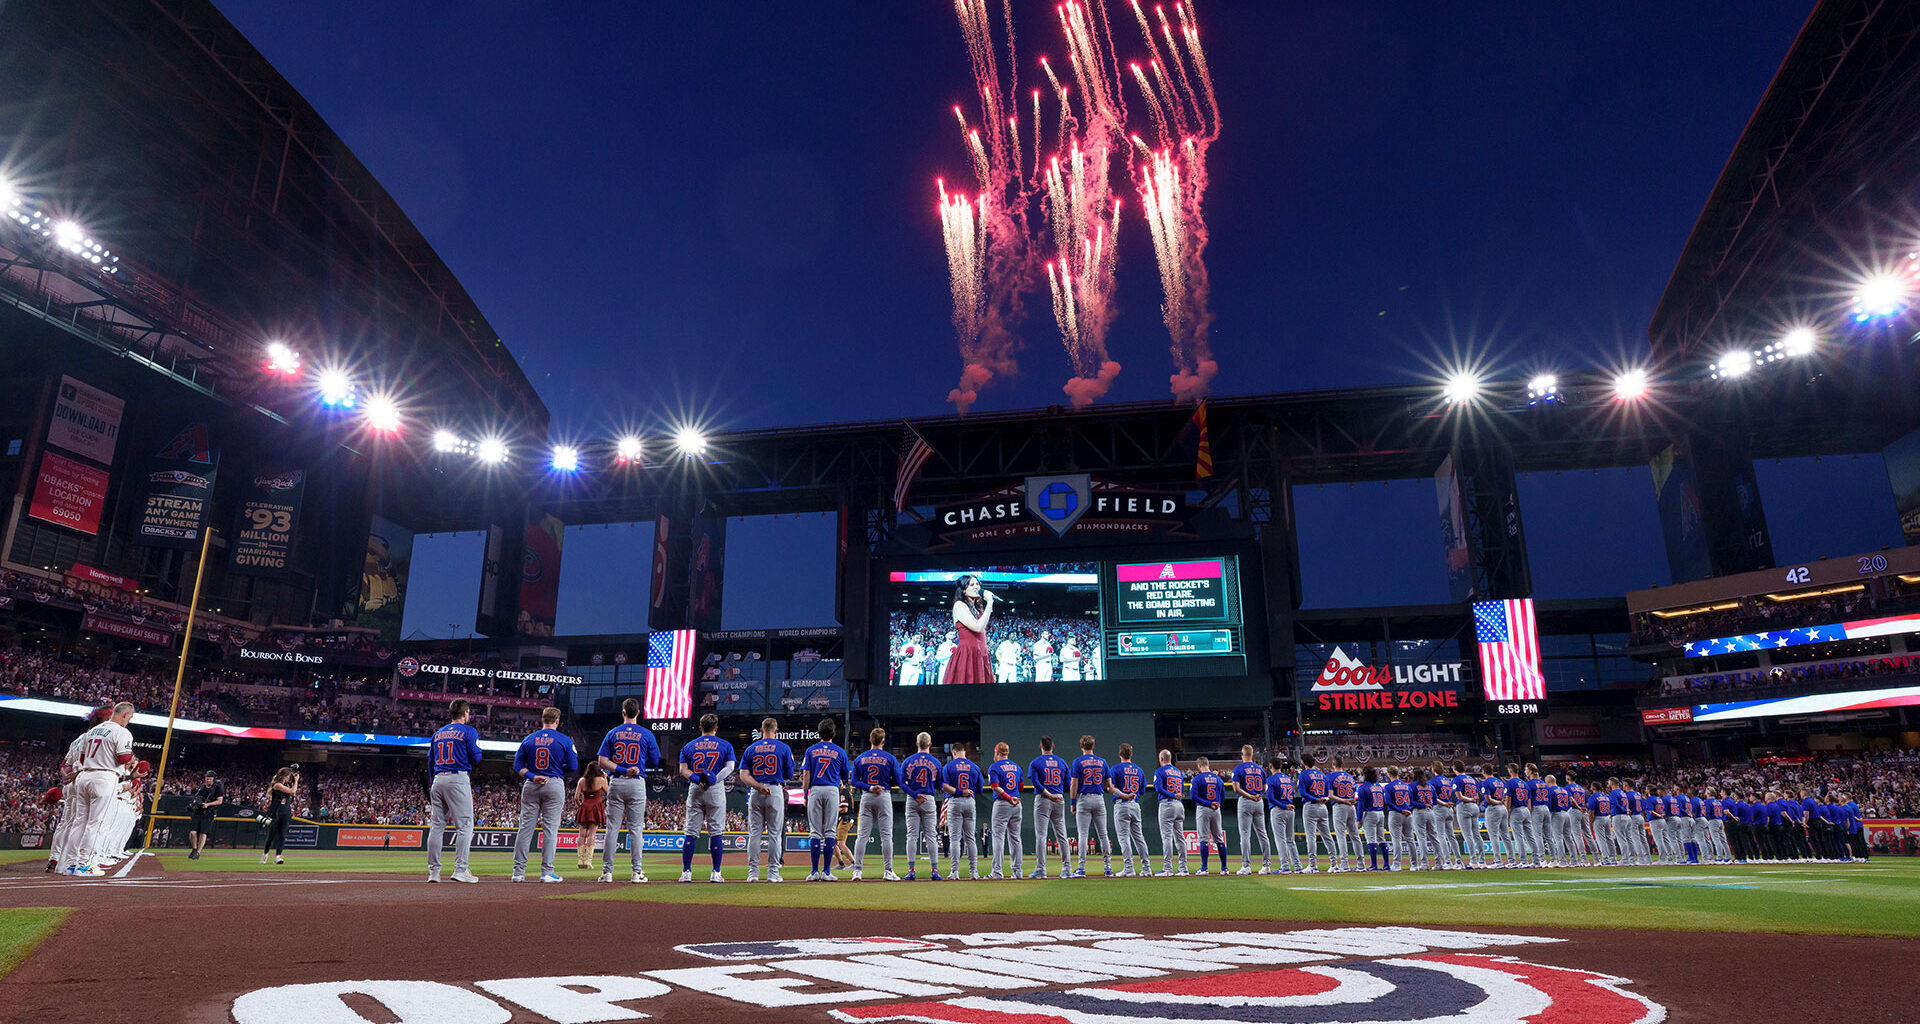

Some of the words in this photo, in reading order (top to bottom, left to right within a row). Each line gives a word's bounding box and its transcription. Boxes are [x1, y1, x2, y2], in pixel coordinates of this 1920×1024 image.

[56, 403, 106, 434] DOWNLOAD
[107, 423, 118, 438] IT
[271, 477, 296, 490] Back
[49, 487, 92, 507] LOCATION
[147, 497, 203, 512] STREAM
[52, 506, 81, 522] 69050
[145, 507, 168, 518] ANY
[171, 510, 201, 521] GAME
[245, 501, 294, 512] CELEBRATING
[944, 502, 1021, 525] CHASE
[1098, 497, 1177, 514] FIELD
[143, 516, 200, 529] ANYWHERE
[244, 508, 293, 532] $93
[240, 529, 289, 543] MILLION
[972, 530, 998, 539] HOME
[1004, 527, 1017, 535] OF
[1023, 525, 1041, 533] THE
[1076, 522, 1149, 532] DIAMONDBACKS
[237, 547, 287, 558] CHARITABLE
[258, 541, 268, 549] IN
[235, 555, 285, 569] GIVING
[1857, 554, 1888, 574] 20
[89, 569, 124, 584] Honeywell
[1785, 566, 1811, 584] 42
[1131, 583, 1149, 591] AND
[1151, 582, 1168, 590] THE
[1169, 580, 1210, 589] ROCKET'S
[1147, 591, 1163, 600] RED
[1127, 601, 1144, 609] THE
[1146, 600, 1171, 609] BOMB
[1172, 598, 1216, 608] BURSTING
[1156, 609, 1166, 617] IN
[144, 630, 161, 641] SEATS
[711, 631, 728, 639] WEST
[729, 630, 766, 638] CHAMPIONS
[800, 627, 837, 636] CHAMPIONS
[1182, 635, 1190, 643] AZ
[285, 652, 293, 661] &
[421, 664, 450, 674] COLD
[451, 666, 487, 677] BEERS
[487, 669, 495, 678] &
[496, 670, 583, 685] CHEESEBURGERS
[1317, 657, 1394, 686] Coors
[1394, 664, 1462, 684] LIGHT
[713, 682, 728, 690] WILD
[728, 681, 748, 690] CARD
[781, 680, 791, 689] NL
[792, 678, 832, 688] CHAMPIONS
[1318, 692, 1394, 710] STRIKE
[1397, 690, 1459, 709] ZONE
[1498, 704, 1521, 714] 6:58
[1522, 704, 1539, 714] PM
[1668, 713, 1691, 721] METER
[651, 722, 669, 733] 6:58
[670, 722, 682, 732] PM
[776, 730, 799, 741] nner
[800, 729, 820, 741] Hea
[1568, 727, 1600, 736] FITNESS
[535, 736, 555, 746] HAPP
[614, 731, 642, 742] TUCKER
[87, 739, 103, 759] 17
[435, 741, 456, 765] 11
[613, 741, 641, 765] 30
[535, 747, 550, 770] 8
[693, 751, 720, 774] 27
[752, 754, 778, 776] 29
[817, 757, 831, 778] 7
[867, 765, 879, 785] 2
[915, 767, 927, 788] 4
[957, 773, 970, 790] 6
[1006, 771, 1017, 790] 3
[1043, 768, 1061, 786] 16
[1083, 767, 1103, 785] 25
[1122, 774, 1139, 792] 15
[1245, 775, 1262, 791] 50
[1167, 776, 1182, 794] 55
[1206, 783, 1216, 800] 5
[1281, 784, 1294, 800] 72
[1310, 780, 1325, 796] 49
[1337, 782, 1354, 798] 66
[1372, 792, 1384, 807] 18
[1395, 791, 1410, 806] 54
[1417, 790, 1433, 805] 33
[1439, 786, 1453, 800] 37
[1535, 788, 1549, 801] 32
[563, 836, 574, 845] THE
[643, 836, 674, 847] HASE
[231, 938, 1350, 1024] OPENING
[1164, 925, 1570, 957] DAY
